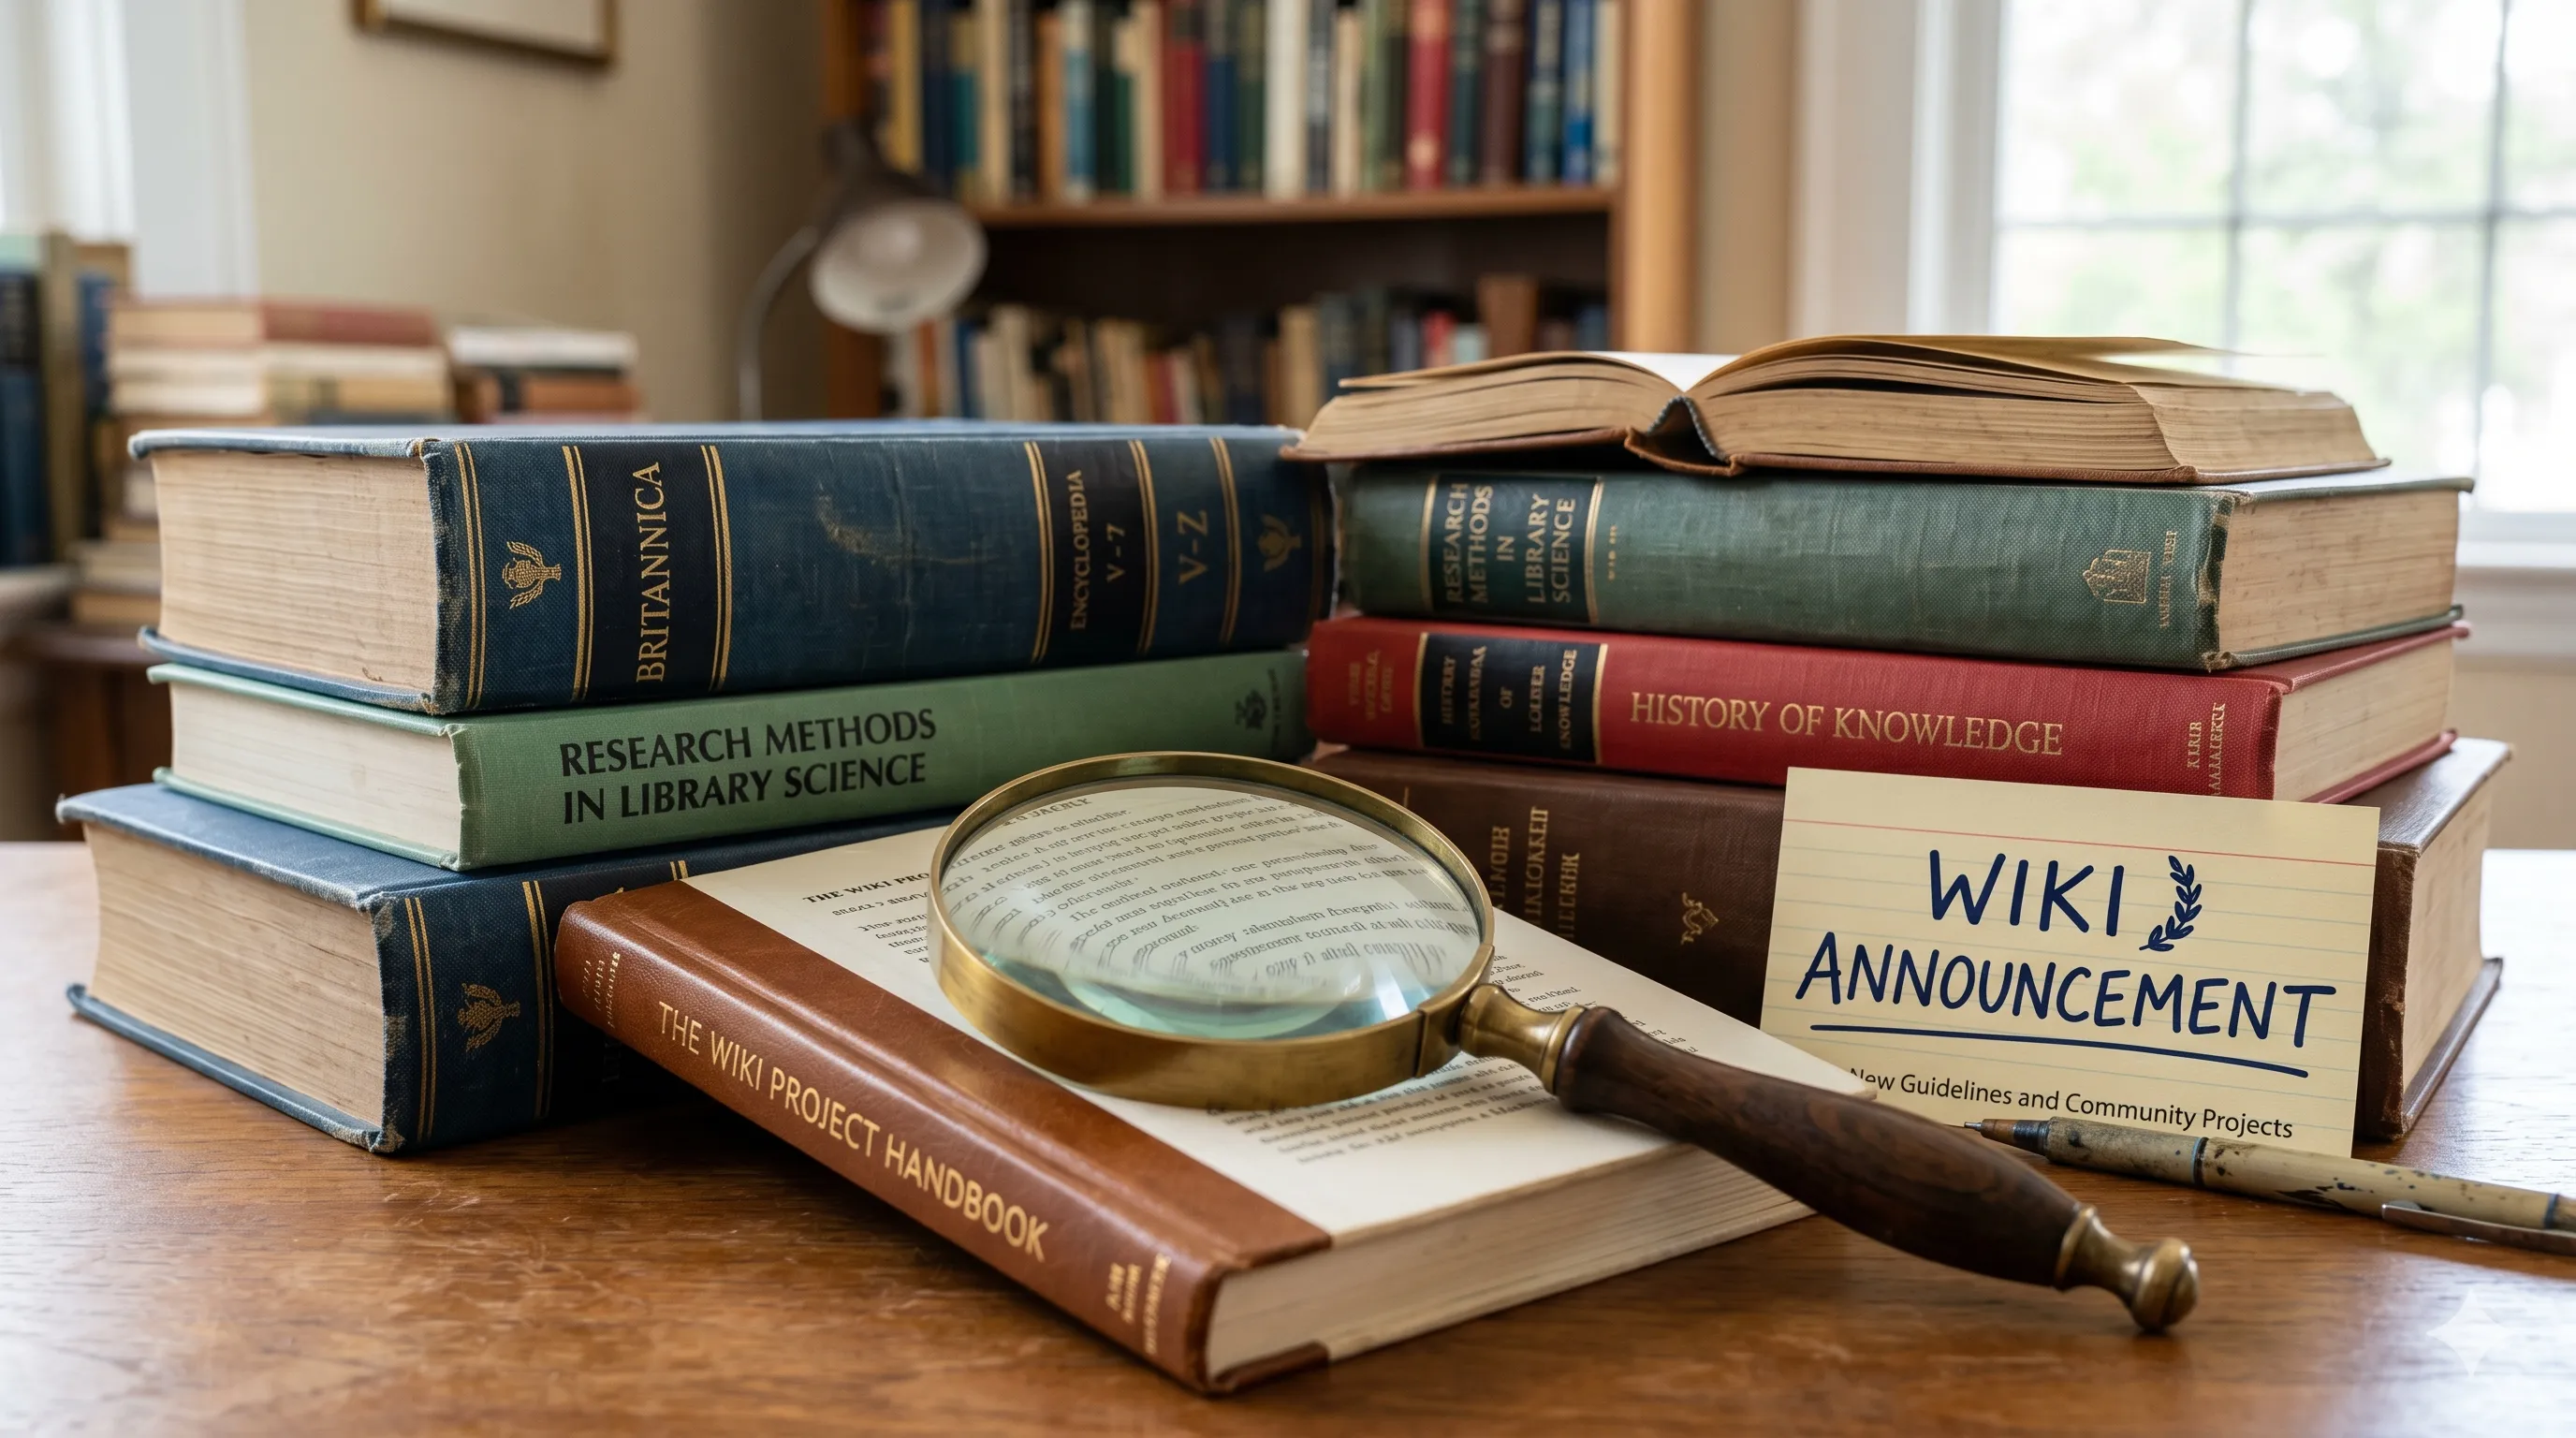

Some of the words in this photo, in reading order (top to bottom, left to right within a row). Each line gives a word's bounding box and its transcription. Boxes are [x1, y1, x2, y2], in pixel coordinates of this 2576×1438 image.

[637, 462, 670, 683] BRITANNICA
[1066, 470, 1090, 631] ENCYCLOPEDIA
[1442, 483, 1470, 603] RESEARCH
[1469, 485, 1494, 603] METHODS
[1497, 535, 1515, 562] IN
[1525, 492, 1550, 604] LIBRARY
[1550, 498, 1576, 603] SCIENCE
[561, 726, 752, 778] RESEARCH
[765, 708, 936, 756] METHODS
[1632, 692, 1772, 733] HISTORY
[1780, 702, 1824, 738] OF
[1834, 706, 2064, 756] KNOWLEDGE
[564, 789, 605, 825] IN
[622, 769, 774, 819] LIBRARY
[784, 752, 926, 800] SCIENCE
[802, 890, 844, 903] THE
[844, 880, 893, 894] WIKI
[1929, 849, 2125, 937] WIKI
[1794, 931, 2337, 1049] ANNOUNCEMENT
[659, 1001, 702, 1056] THE
[710, 1030, 764, 1092] WIKI
[769, 1065, 880, 1158] PROJECT
[885, 1133, 1049, 1264] HANDBOOK
[1901, 1074, 2012, 1106] Guidelines
[2018, 1091, 2060, 1110] and
[2065, 1093, 2197, 1132] Community
[2203, 1108, 2293, 1138] Projects
